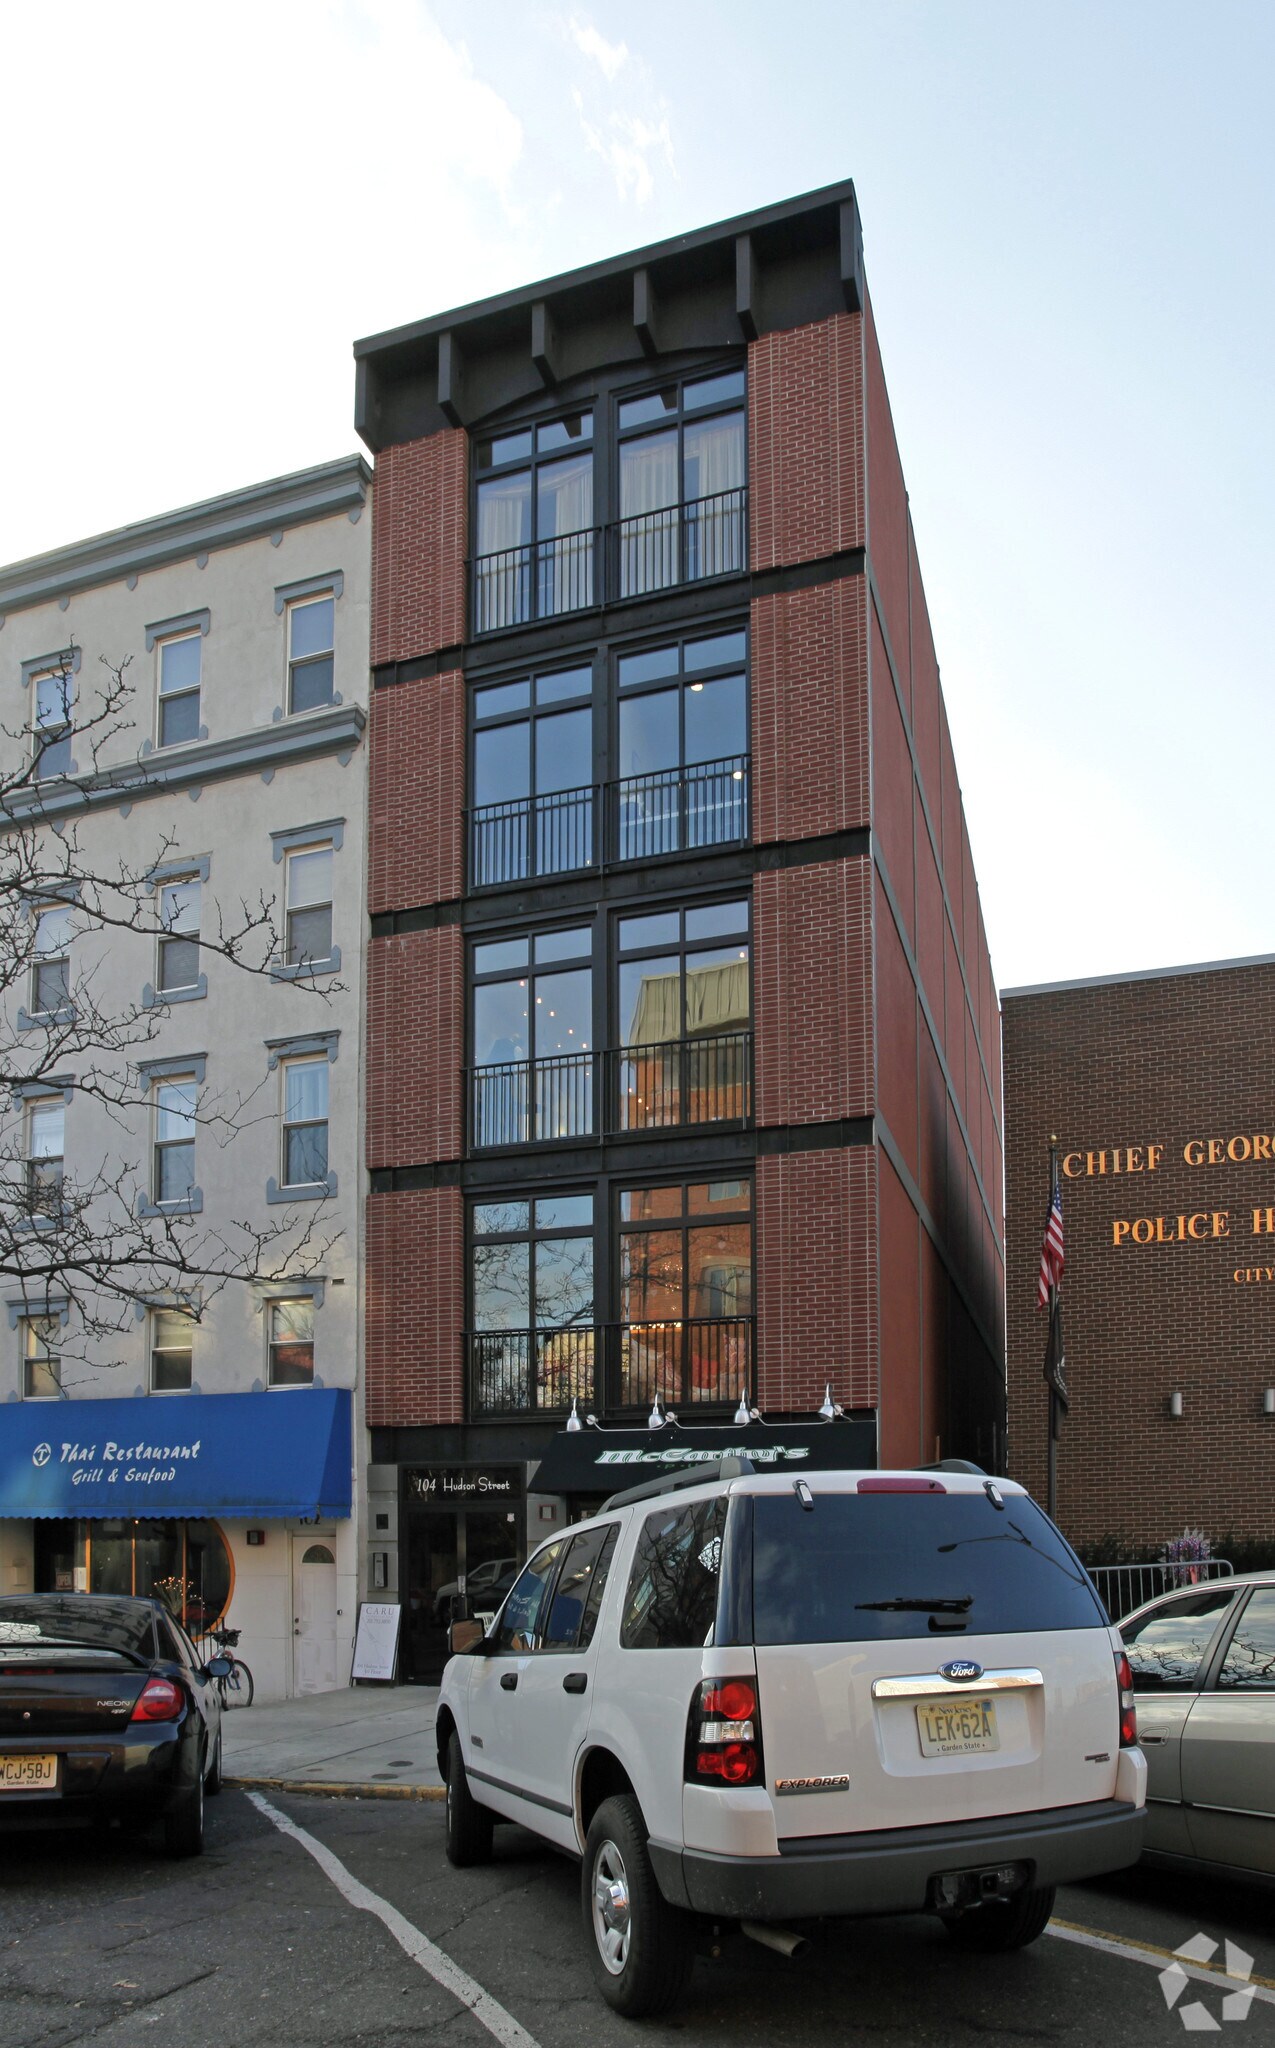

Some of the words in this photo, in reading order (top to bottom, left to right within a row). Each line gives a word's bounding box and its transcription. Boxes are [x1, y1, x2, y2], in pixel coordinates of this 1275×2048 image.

[1062, 1144, 1164, 1178] CHIEF
[1112, 1211, 1230, 1246] POLICE
[1233, 1266, 1275, 1283] CITY
[59, 1442, 97, 1464] Thai
[102, 1439, 202, 1462] Restaurant
[71, 1467, 104, 1486] Grill
[107, 1467, 119, 1483] &
[124, 1466, 177, 1485] Seafood
[416, 1477, 437, 1493] 104
[443, 1477, 476, 1493] Hudson
[478, 1476, 511, 1492] Street
[950, 1662, 976, 1677] Ford
[941, 1743, 963, 1752] Garden
[964, 1742, 981, 1751] State
[778, 1776, 849, 1790] EXPLORER
